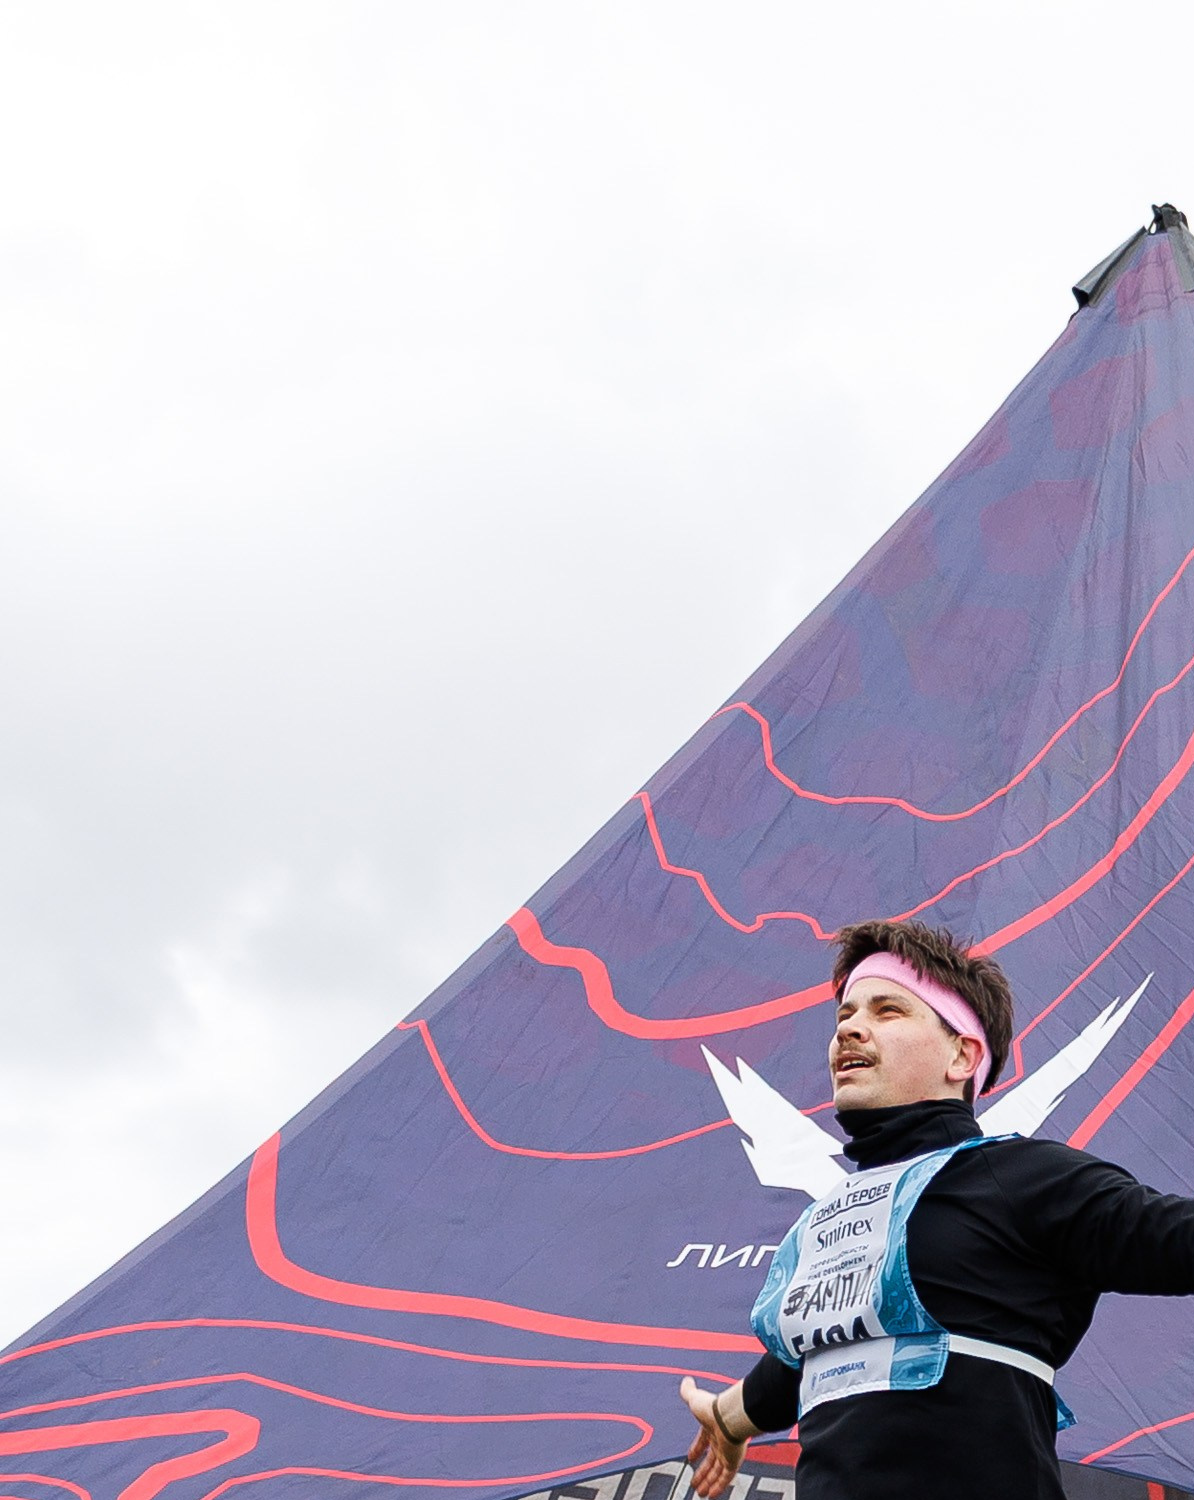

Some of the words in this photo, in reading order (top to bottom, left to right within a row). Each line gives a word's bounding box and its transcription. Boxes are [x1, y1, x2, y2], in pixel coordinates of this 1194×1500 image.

[811, 1198, 842, 1225] ГОНКА
[844, 1182, 892, 1206] ГЕРОЕВ
[815, 1217, 874, 1253] Sminex
